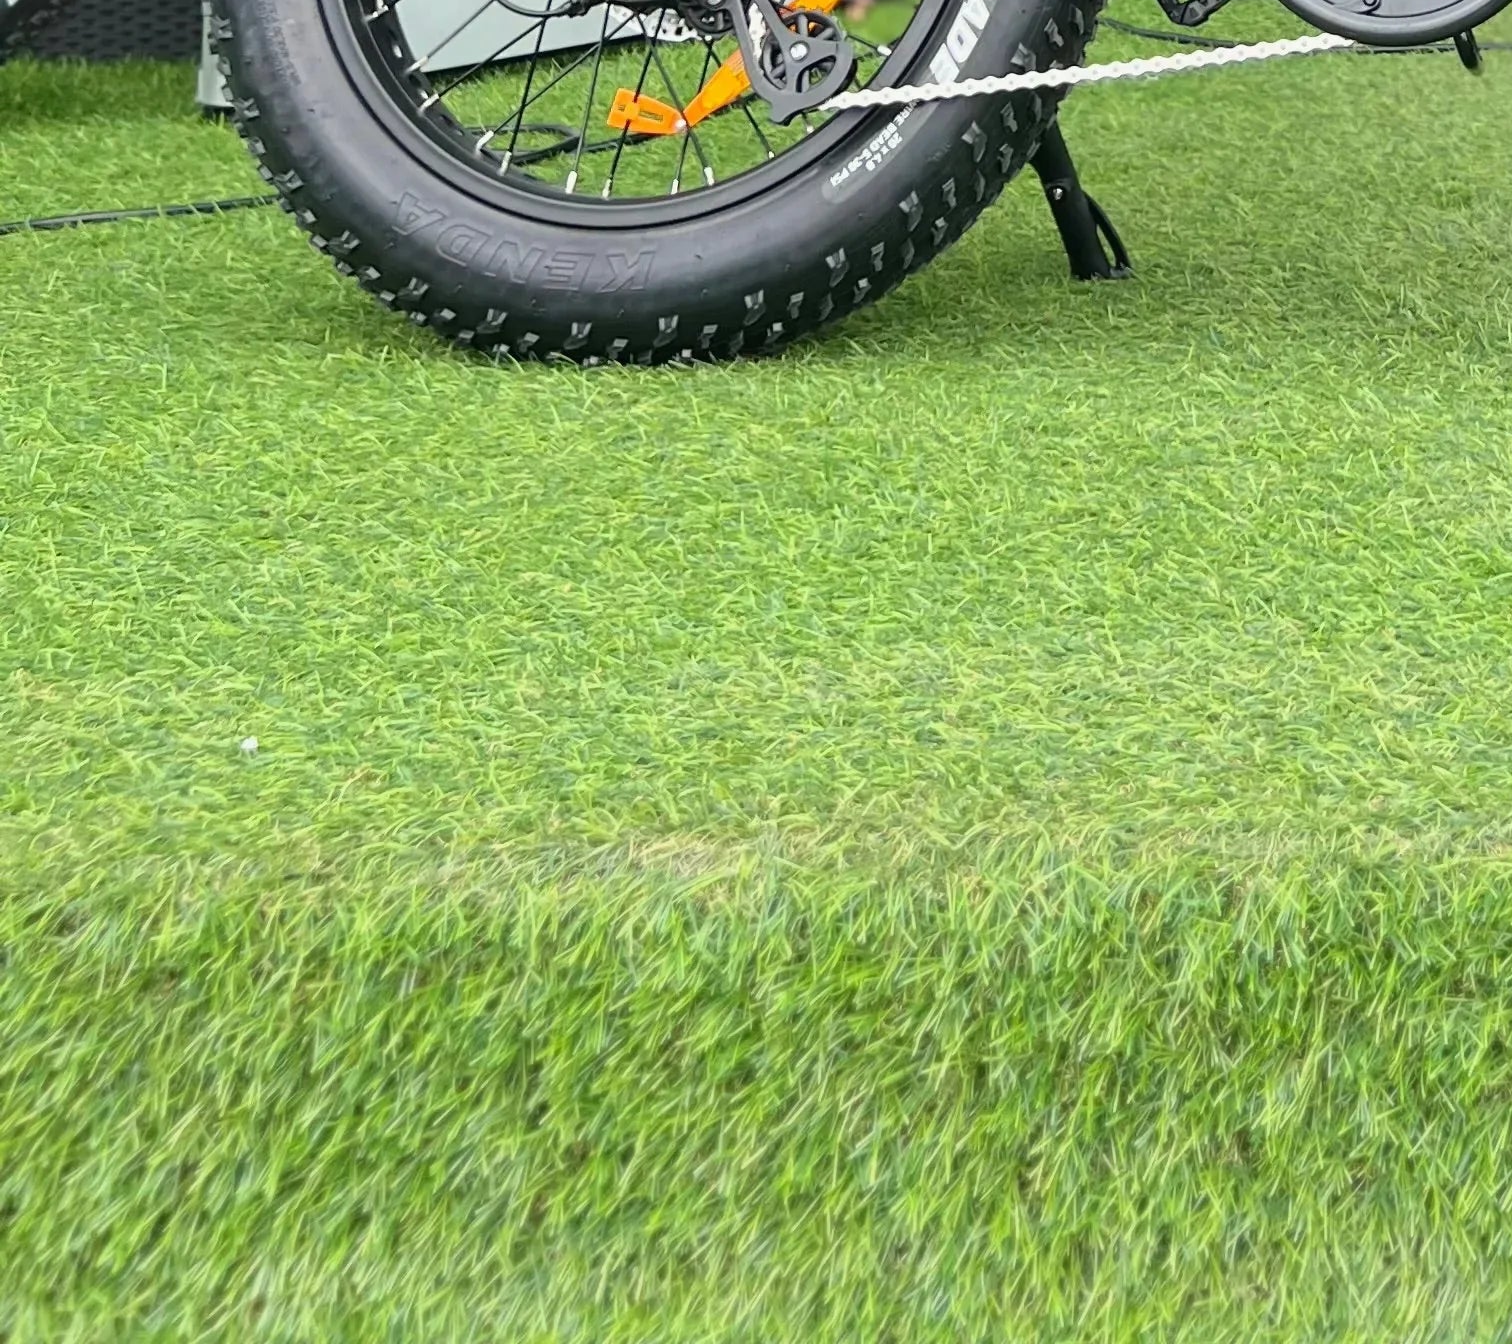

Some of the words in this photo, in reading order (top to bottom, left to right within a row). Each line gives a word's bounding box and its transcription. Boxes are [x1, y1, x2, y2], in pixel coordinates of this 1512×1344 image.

[867, 121, 898, 153] BEAD
[828, 166, 851, 188] PSI
[392, 191, 656, 293] KENDA
